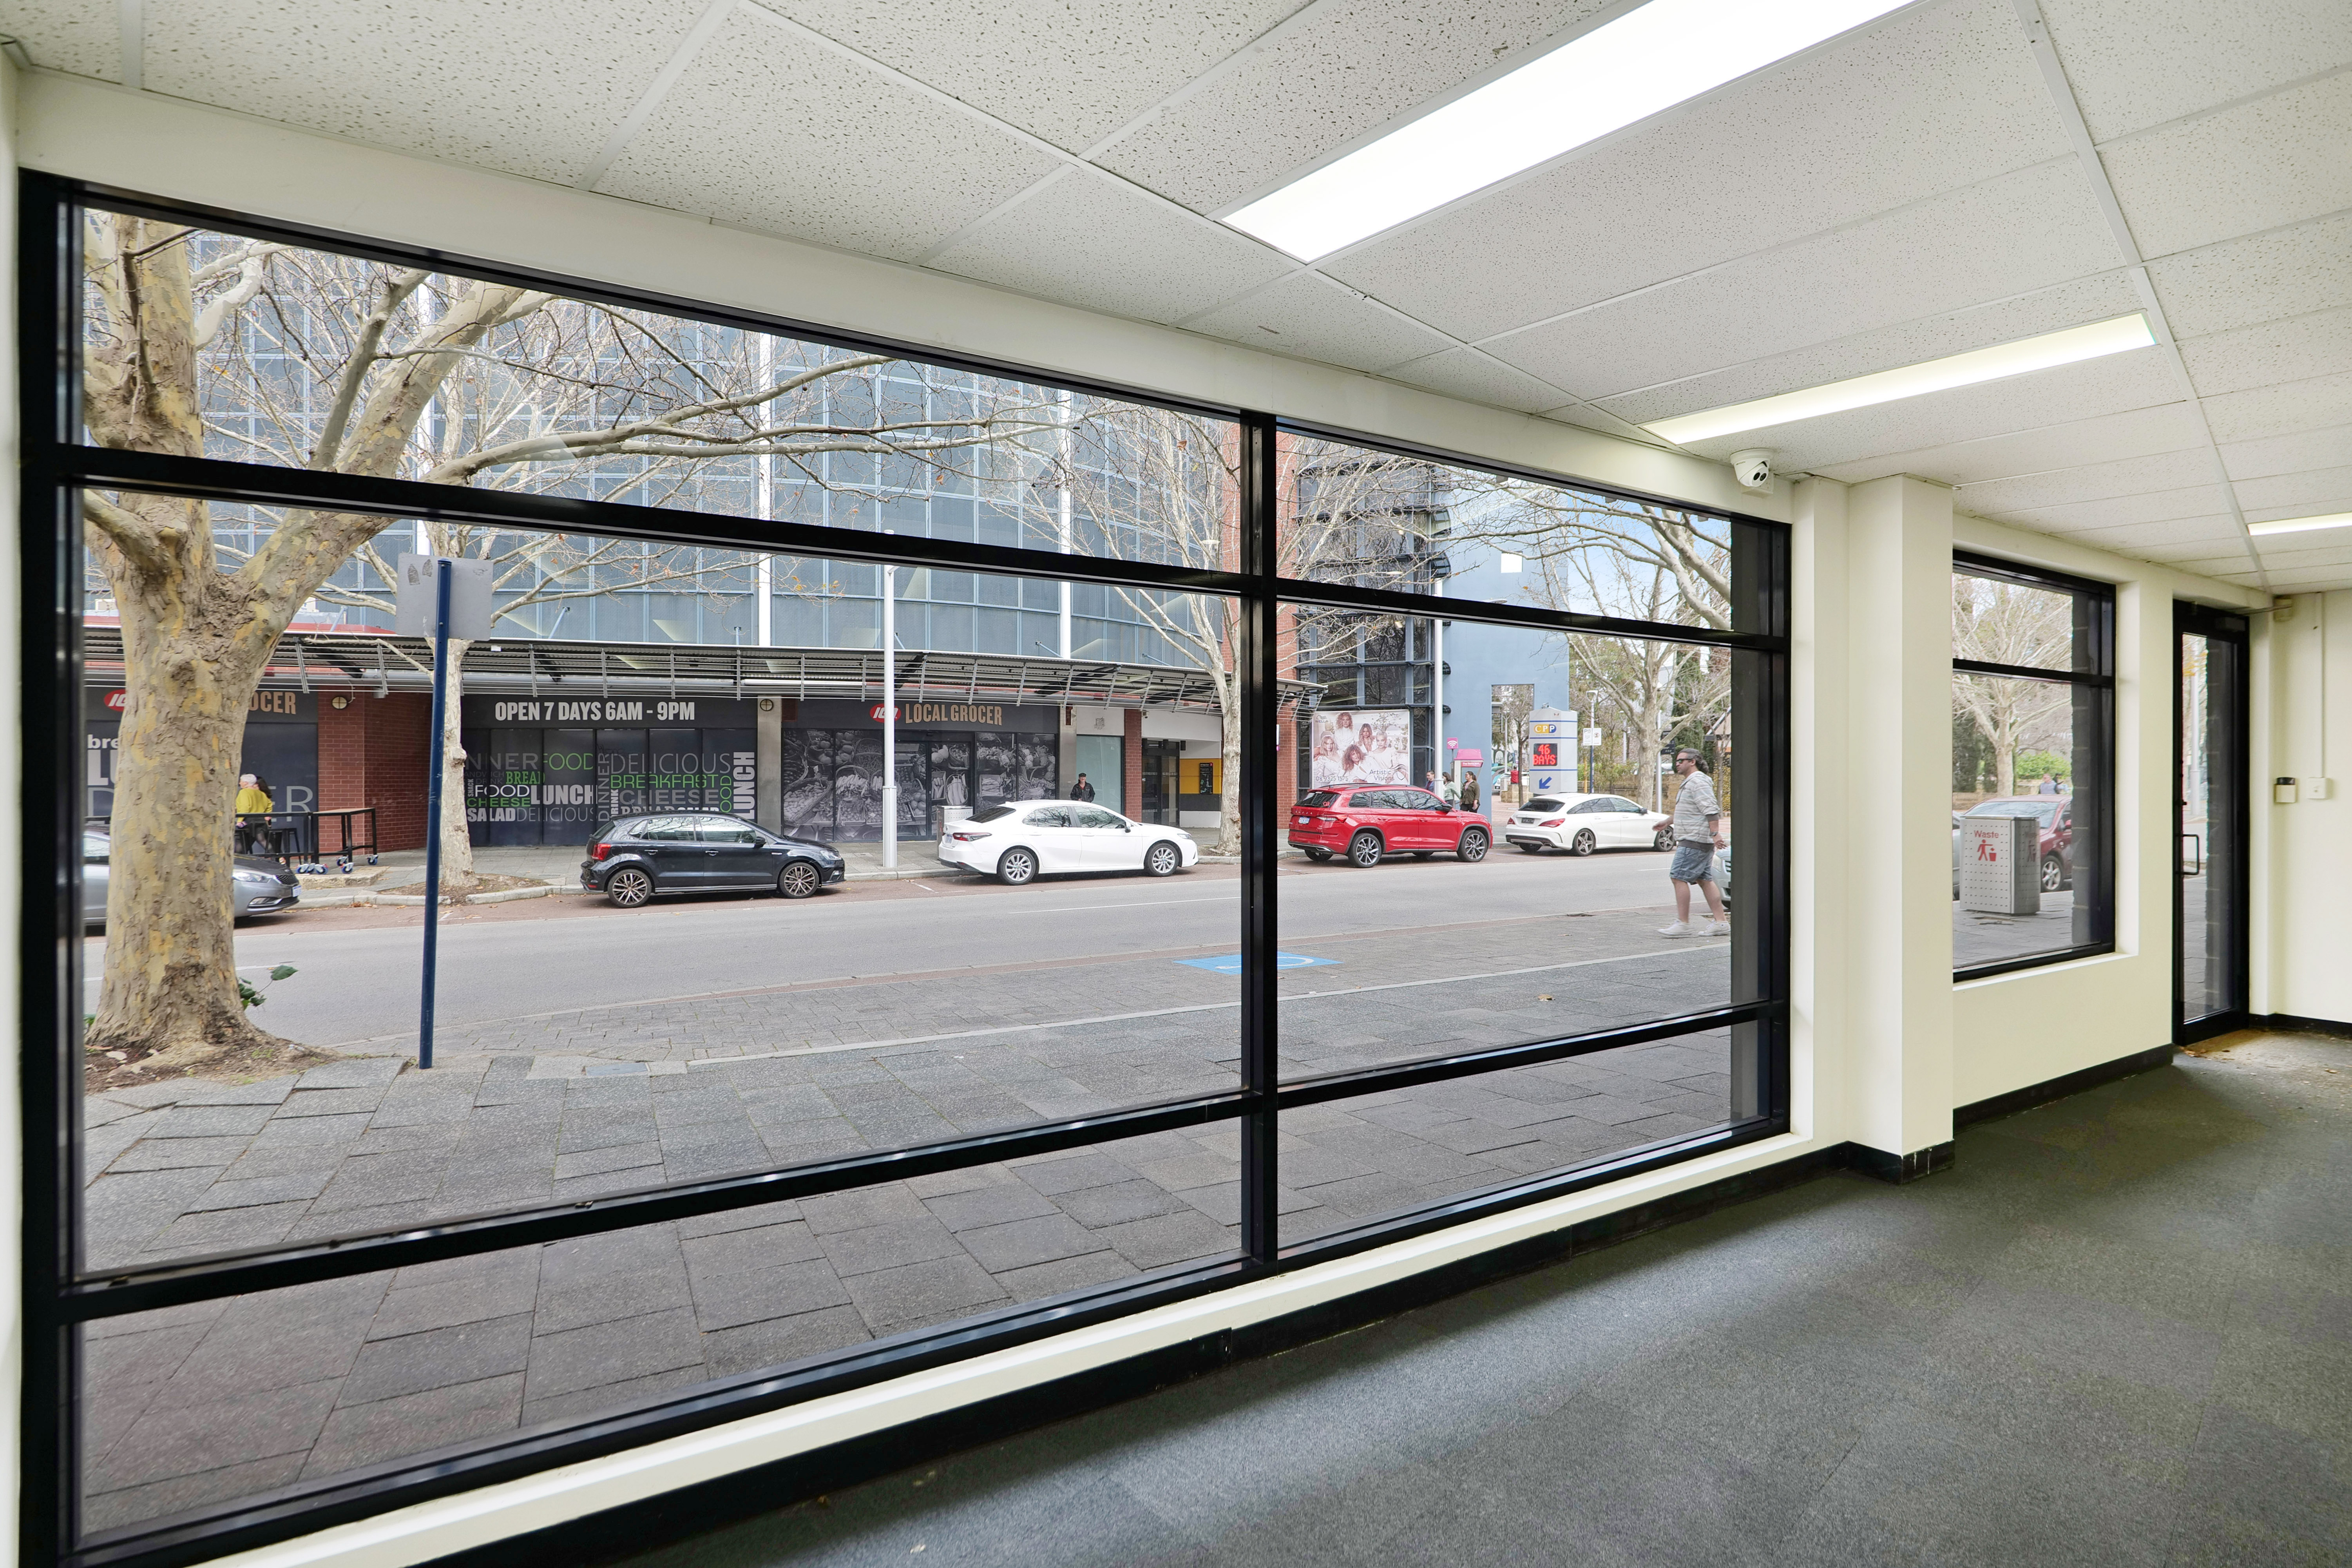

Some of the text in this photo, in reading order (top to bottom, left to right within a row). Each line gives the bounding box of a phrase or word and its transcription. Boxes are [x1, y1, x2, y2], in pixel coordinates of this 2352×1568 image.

[108, 691, 296, 715] IG OCER
[495, 702, 540, 721] OPEN
[544, 702, 554, 721] 7
[558, 702, 601, 721] DAYS
[605, 702, 643, 721] 6AM
[657, 702, 695, 721] 9PM
[905, 703, 948, 724] LOCAL
[950, 705, 1002, 726] GROCER
[1538, 744, 1552, 755] 46
[465, 753, 539, 770] NNER
[611, 753, 731, 774] DELICIOUS
[1533, 754, 1556, 765] BAYS
[598, 753, 610, 821] DINNER
[610, 774, 719, 788] BREAKFAST
[733, 751, 755, 820] LUNCH
[475, 784, 530, 797] FOOD
[531, 784, 598, 805] LUNCH
[619, 789, 719, 805] CHEESE
[720, 775, 732, 813] OOD
[466, 797, 531, 807] CHEESE
[610, 789, 619, 817] RINK
[467, 808, 516, 822] SALAD
[1974, 830, 1999, 838] Waste
